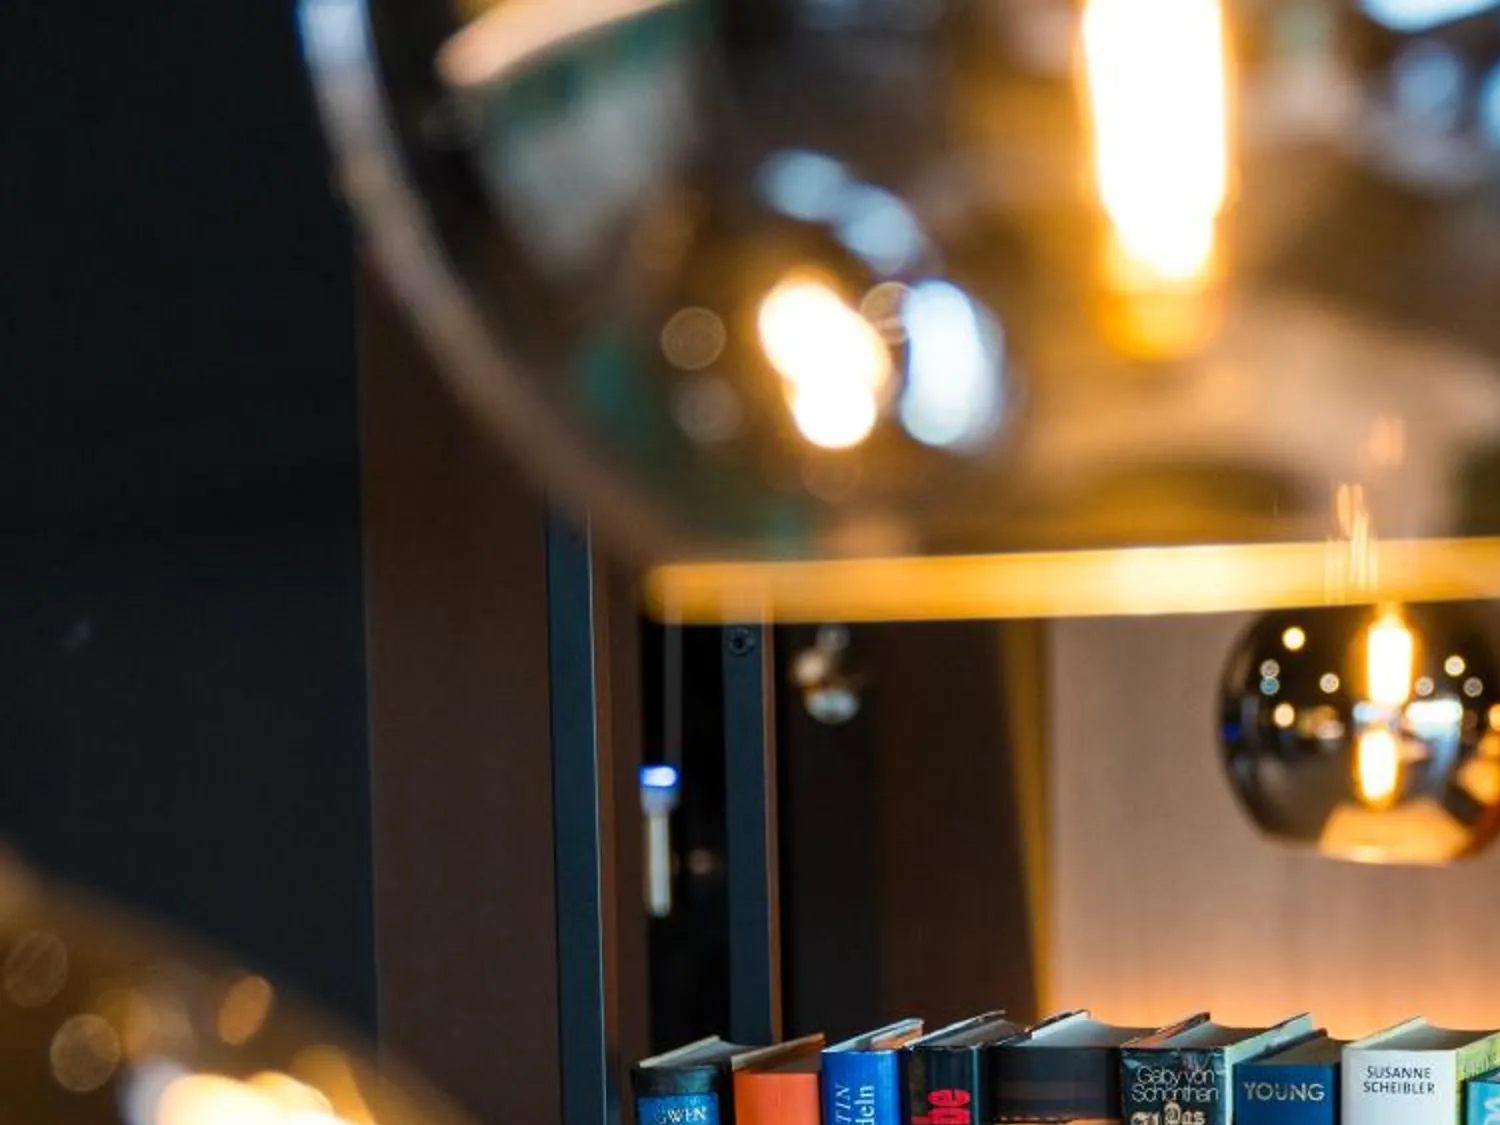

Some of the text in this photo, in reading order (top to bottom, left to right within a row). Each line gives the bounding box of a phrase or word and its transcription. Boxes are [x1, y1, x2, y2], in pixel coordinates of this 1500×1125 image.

[1136, 1065, 1215, 1085] Gaby von
[1366, 1065, 1433, 1079] SUSANNE
[1243, 1081, 1325, 1101] YOUNG
[1362, 1081, 1436, 1095] SCHEIBLER
[1164, 1101, 1206, 1125] Das
